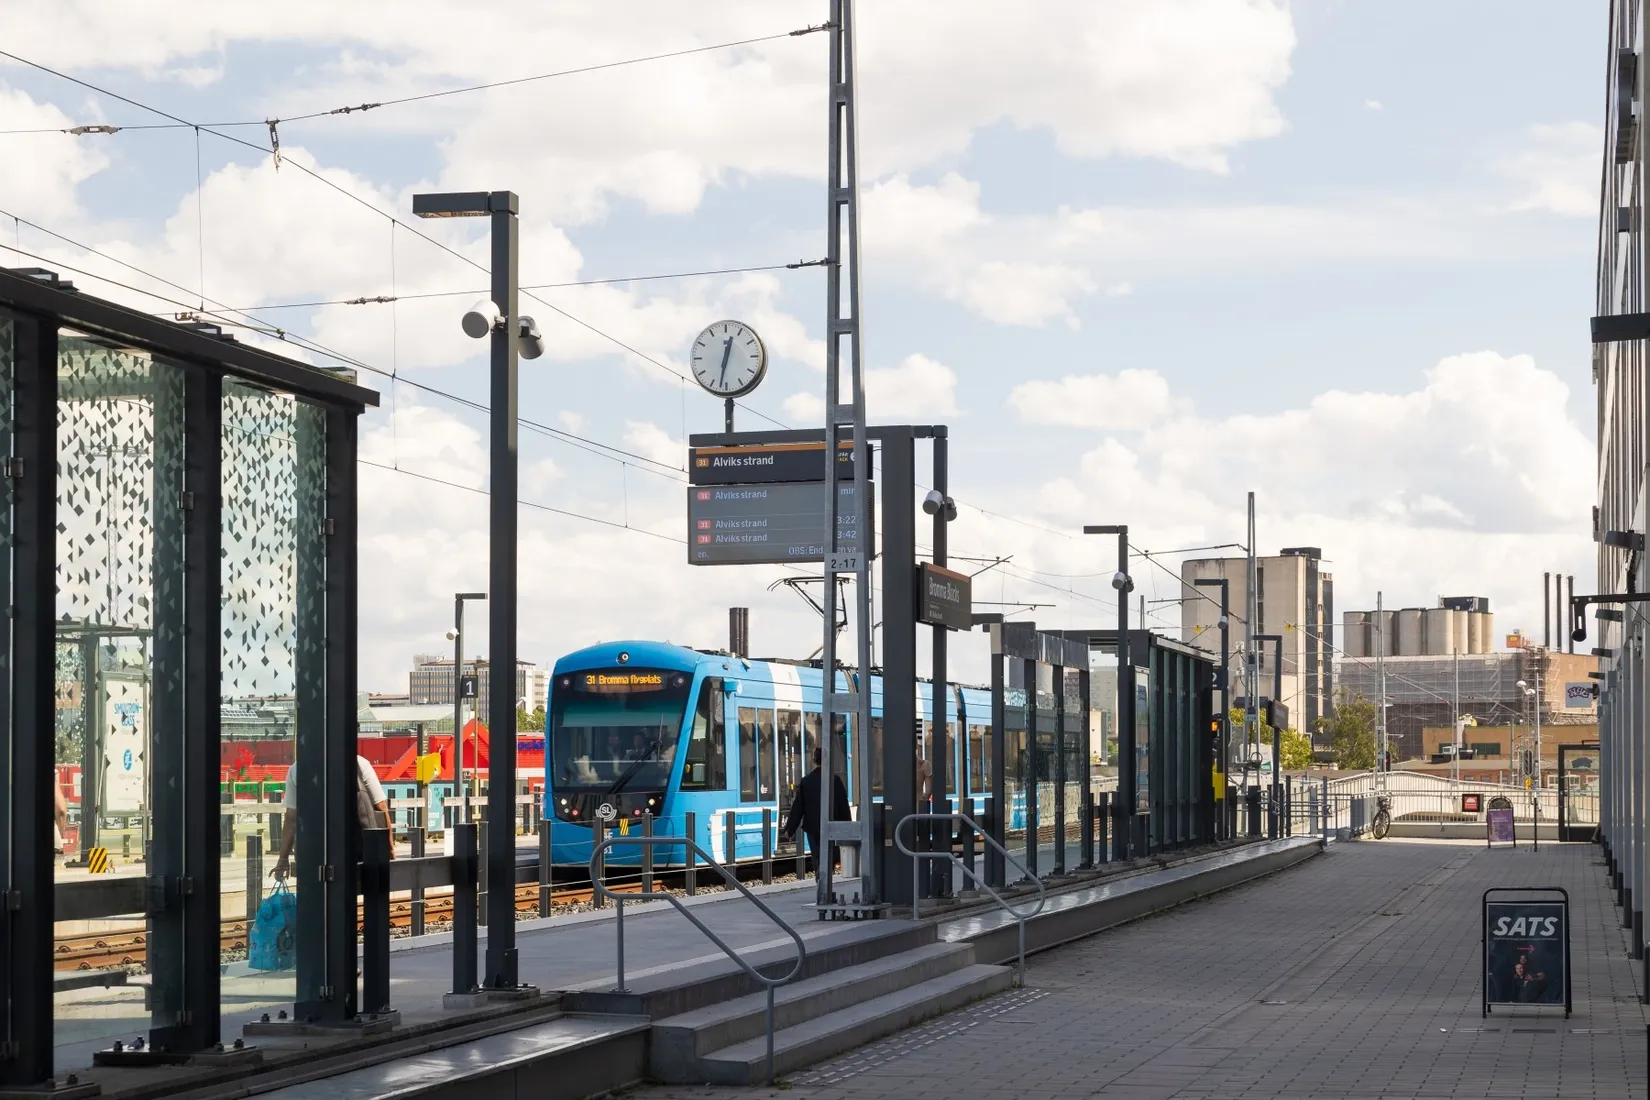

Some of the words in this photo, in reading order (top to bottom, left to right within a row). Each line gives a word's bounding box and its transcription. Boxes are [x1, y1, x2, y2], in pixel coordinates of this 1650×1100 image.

[713, 456, 742, 467] Alviks
[743, 455, 774, 466] strand
[715, 491, 740, 500] Alviks
[740, 490, 768, 499] strand
[715, 520, 740, 529] Alviks
[741, 518, 768, 528] strand
[837, 515, 856, 525] 3:22
[715, 534, 740, 543] Alviks
[741, 533, 768, 542] strand
[837, 530, 857, 539] 3:42
[808, 545, 824, 555] End
[586, 675, 596, 685] 31
[598, 675, 629, 685] Bromma
[465, 680, 475, 696] 1
[601, 806, 611, 814] SL
[1492, 916, 1559, 937] SATS
